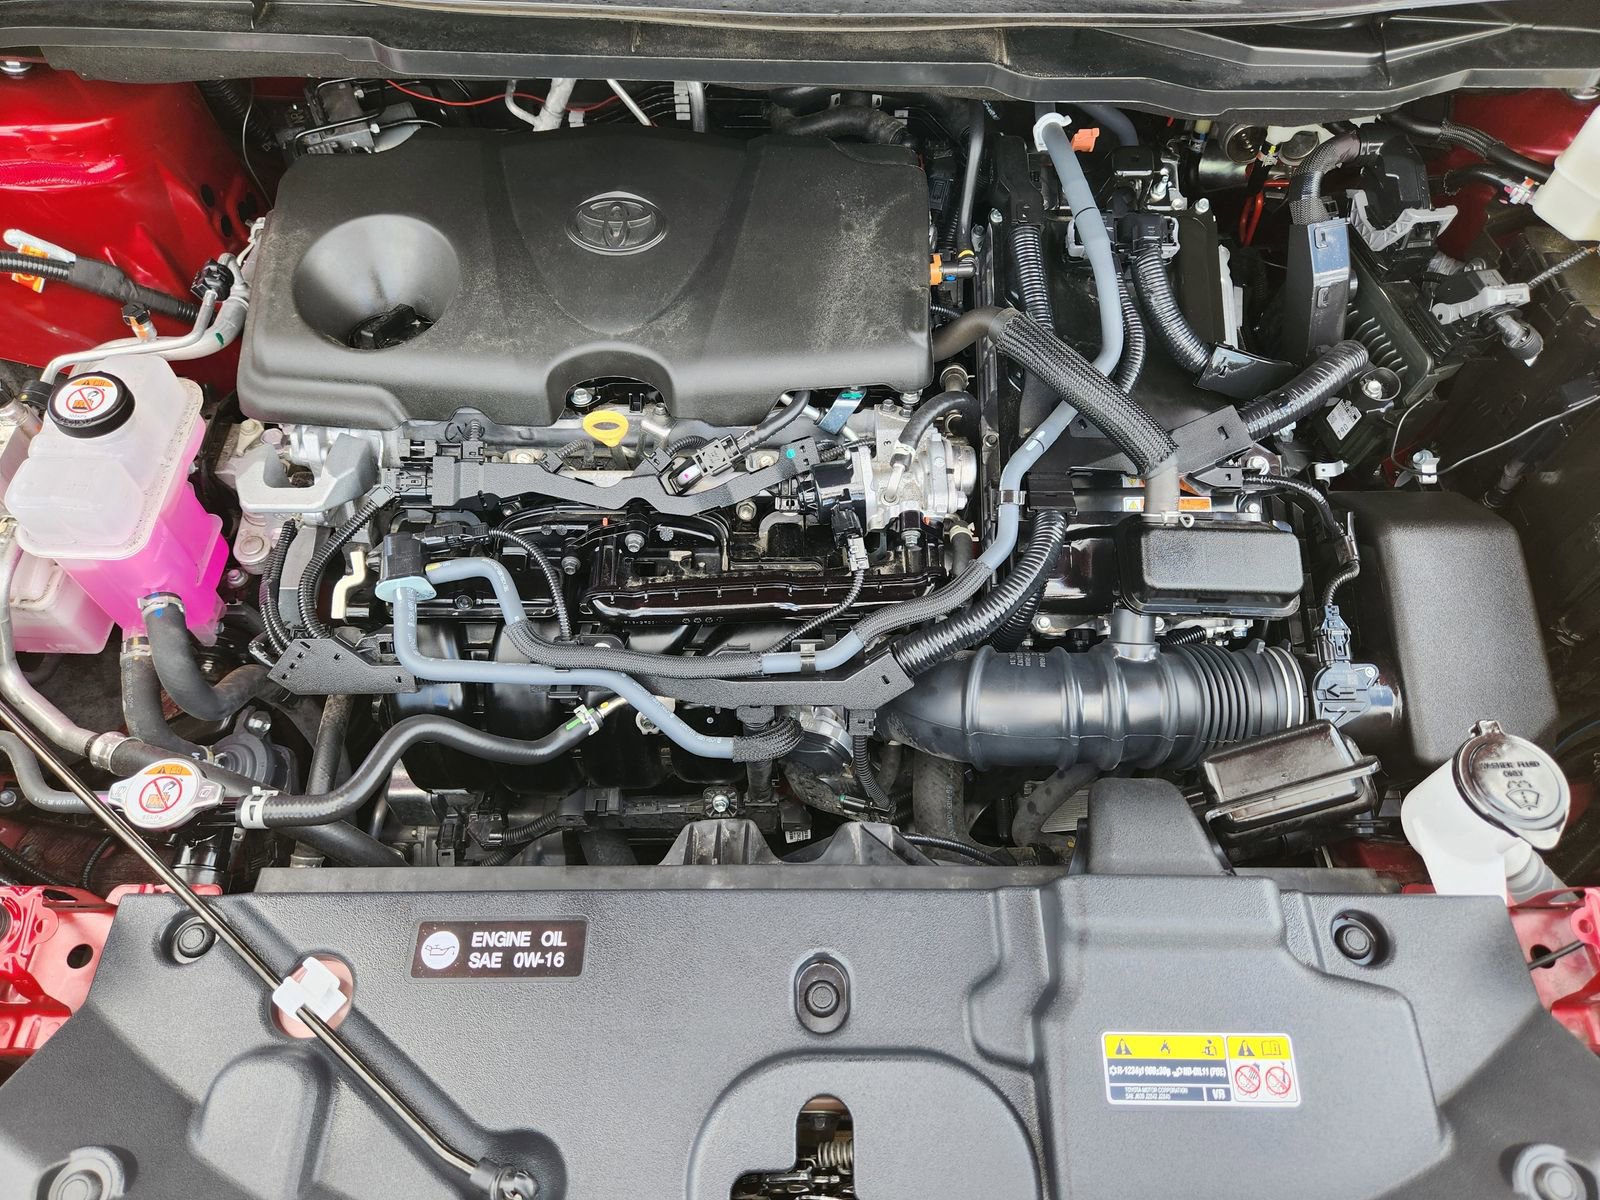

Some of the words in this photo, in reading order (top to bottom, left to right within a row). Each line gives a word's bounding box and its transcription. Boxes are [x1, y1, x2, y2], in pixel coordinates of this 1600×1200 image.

[1517, 760, 1540, 768] FLUID
[1503, 769, 1523, 777] ONLY
[471, 931, 531, 948] ENGINE
[541, 931, 567, 947] OIL
[468, 952, 503, 968] SAE
[513, 952, 565, 969] 0W-16
